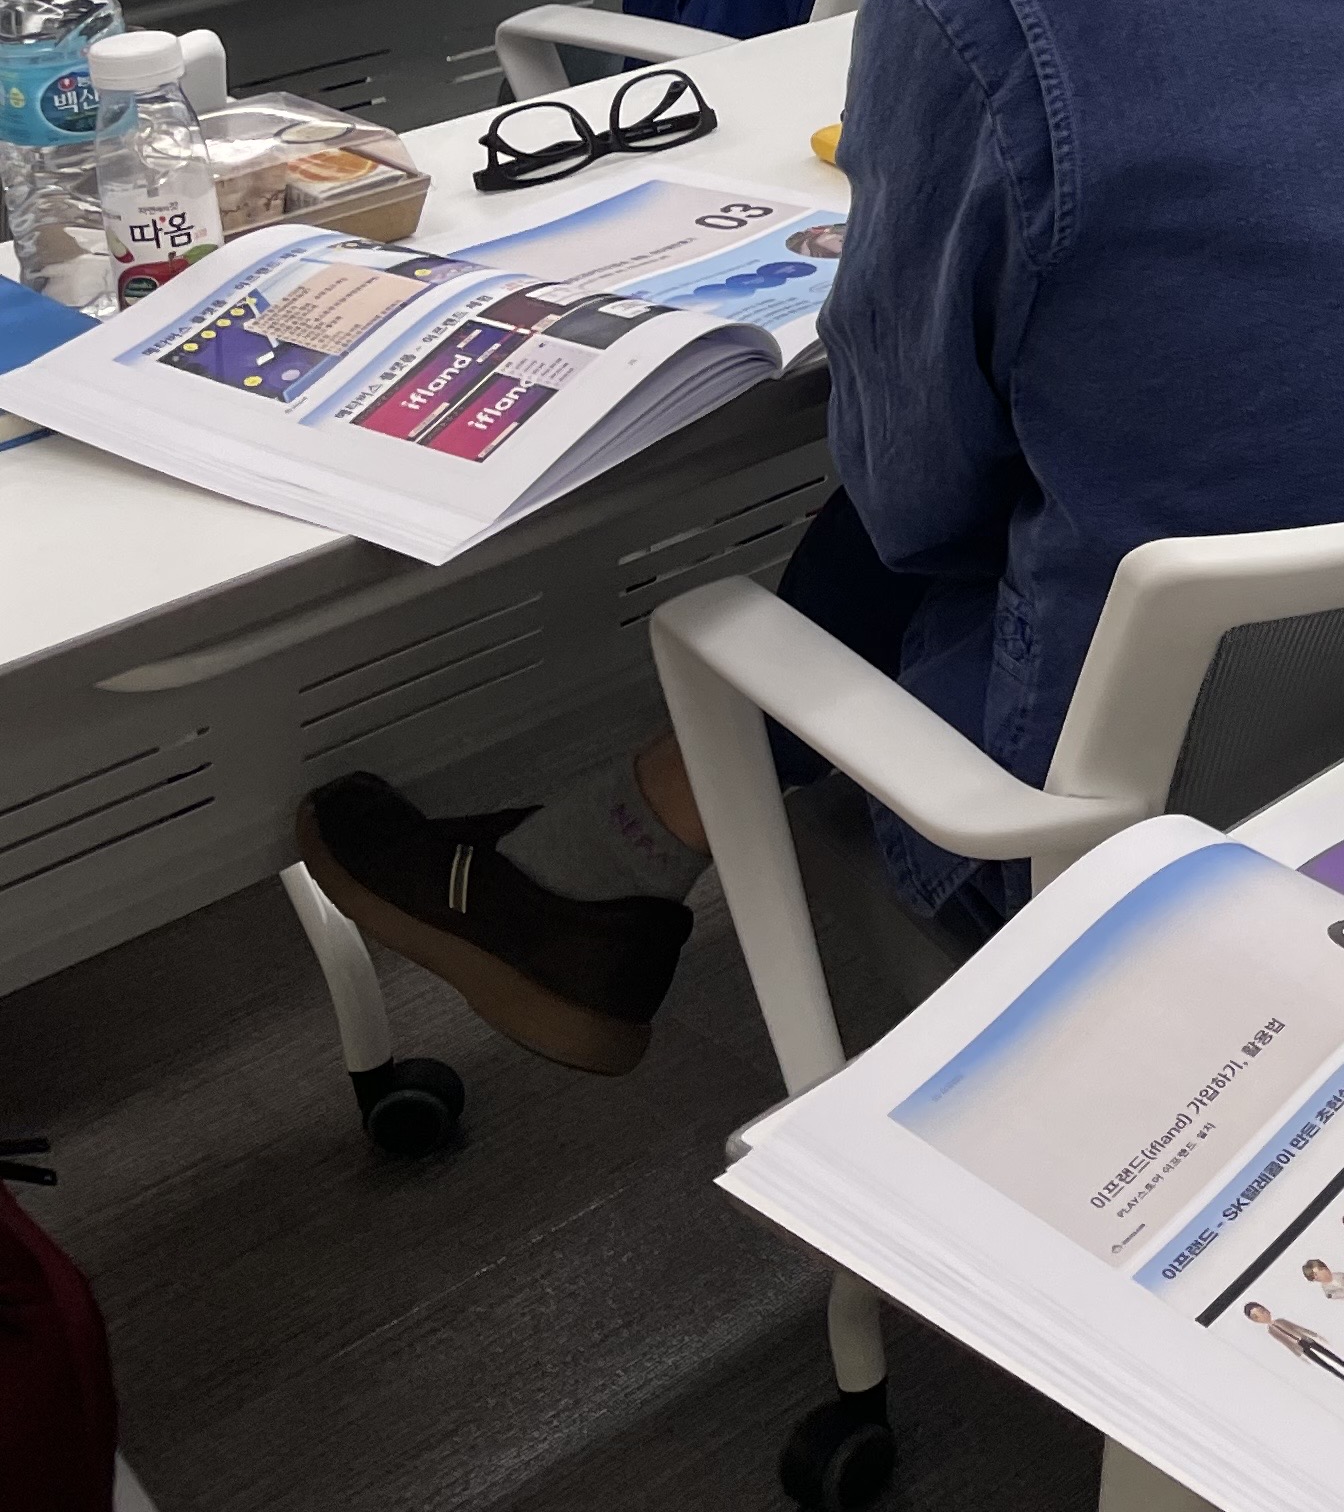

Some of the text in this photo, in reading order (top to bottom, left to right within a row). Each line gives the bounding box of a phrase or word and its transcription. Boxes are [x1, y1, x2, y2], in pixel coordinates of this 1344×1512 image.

[53, 88, 100, 113] 백산
[129, 212, 194, 249] 따옴
[695, 203, 773, 230] 03
[401, 354, 472, 410] ifland
[1090, 1113, 1193, 1209] 이프랜드(ifland)
[1187, 1060, 1249, 1114] 가입하기,
[1241, 1017, 1286, 1058] 활용법
[1162, 1227, 1220, 1280] 이프랜드
[1222, 1148, 1296, 1221] SK텔레콤이
[1289, 1121, 1322, 1151] 만든
